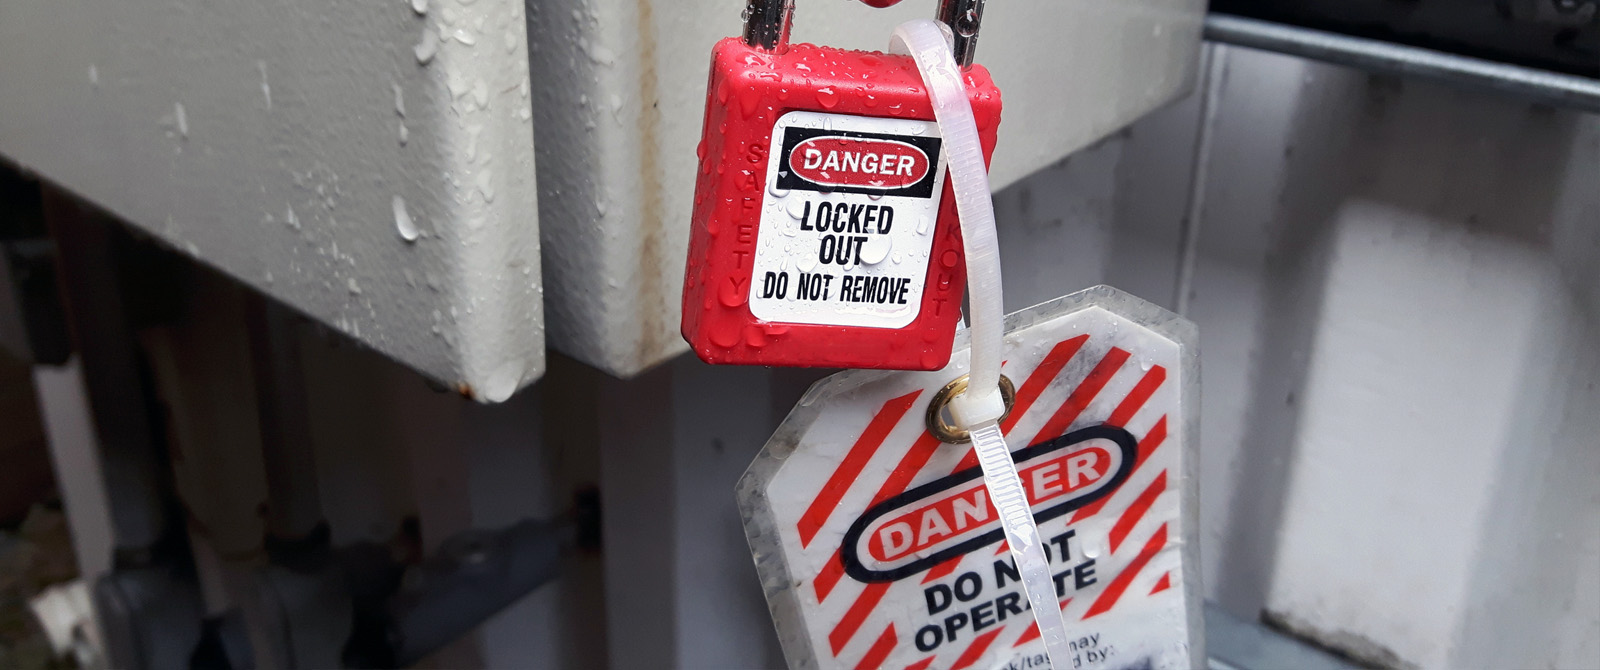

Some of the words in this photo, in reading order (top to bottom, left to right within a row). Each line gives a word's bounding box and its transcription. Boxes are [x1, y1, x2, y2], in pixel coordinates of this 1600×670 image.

[803, 148, 915, 177] DANGER
[729, 143, 764, 295] SAFETY
[800, 200, 894, 235] LOCKED
[818, 234, 868, 266] OUT
[763, 271, 789, 300] DO
[796, 272, 834, 301] NOT
[839, 275, 911, 305] REMOVE
[879, 451, 1100, 560] DANER
[915, 559, 1098, 652] OPERTE
[924, 571, 983, 616] DO
[1087, 645, 1114, 663] by:
